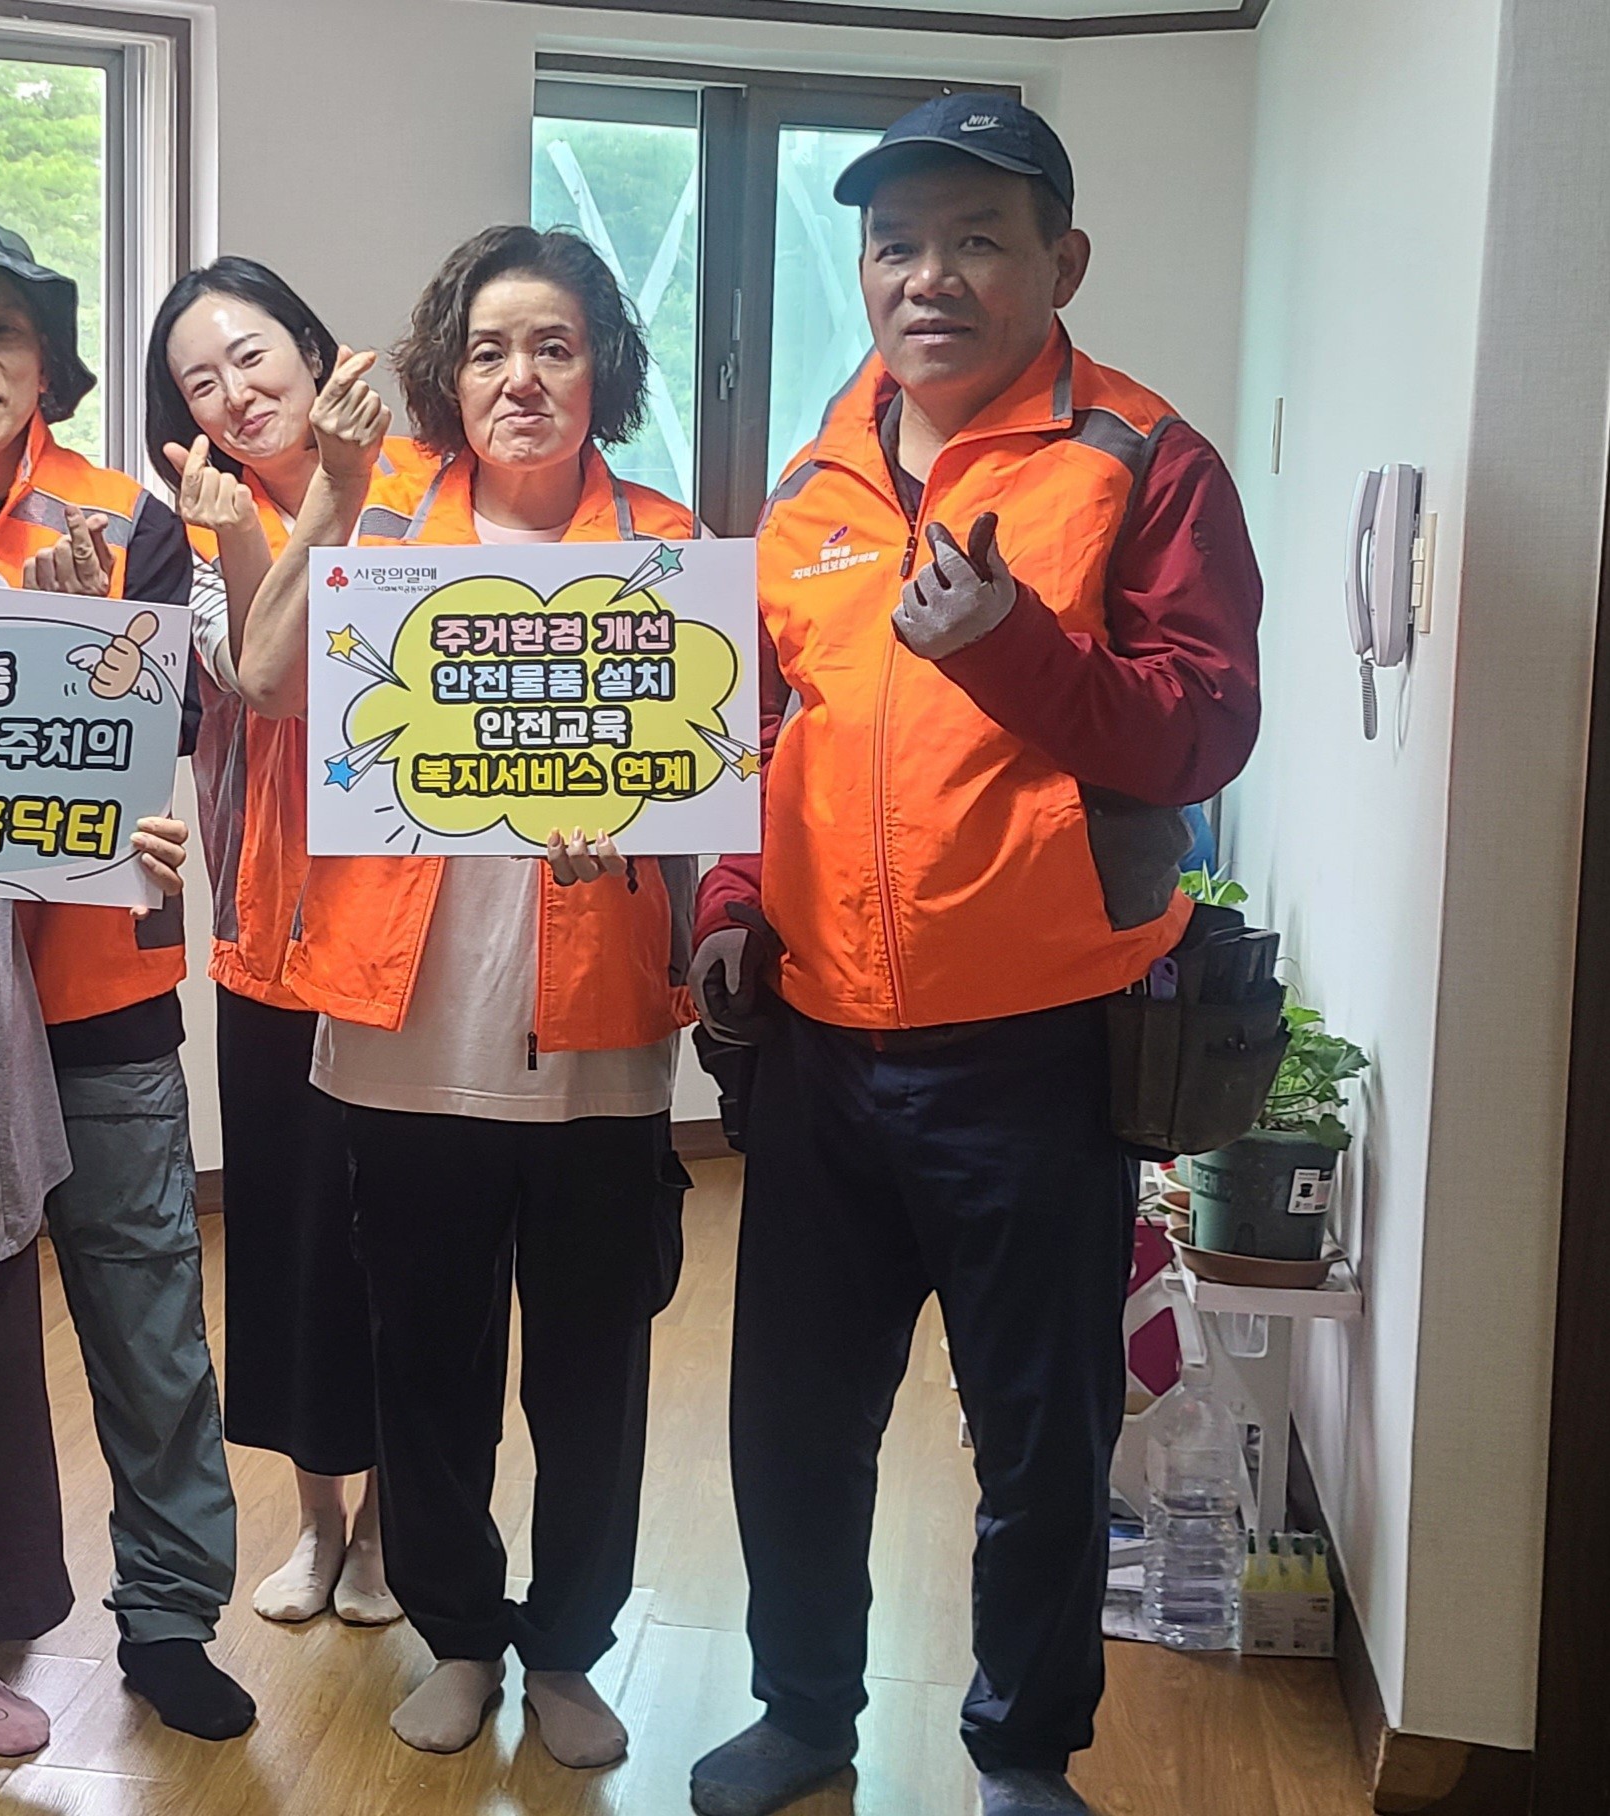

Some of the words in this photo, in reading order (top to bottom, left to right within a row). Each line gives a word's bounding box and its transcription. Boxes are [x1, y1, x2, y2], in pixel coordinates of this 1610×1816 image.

[353, 567, 437, 585] 사랑의열매
[432, 613, 586, 656] 주거환경
[594, 611, 675, 653] 개선
[432, 660, 588, 702] 안전물품
[595, 659, 674, 700] 설치
[476, 707, 630, 749] 안전교육
[414, 755, 605, 795] 복지서비스
[614, 754, 694, 794] 연계
